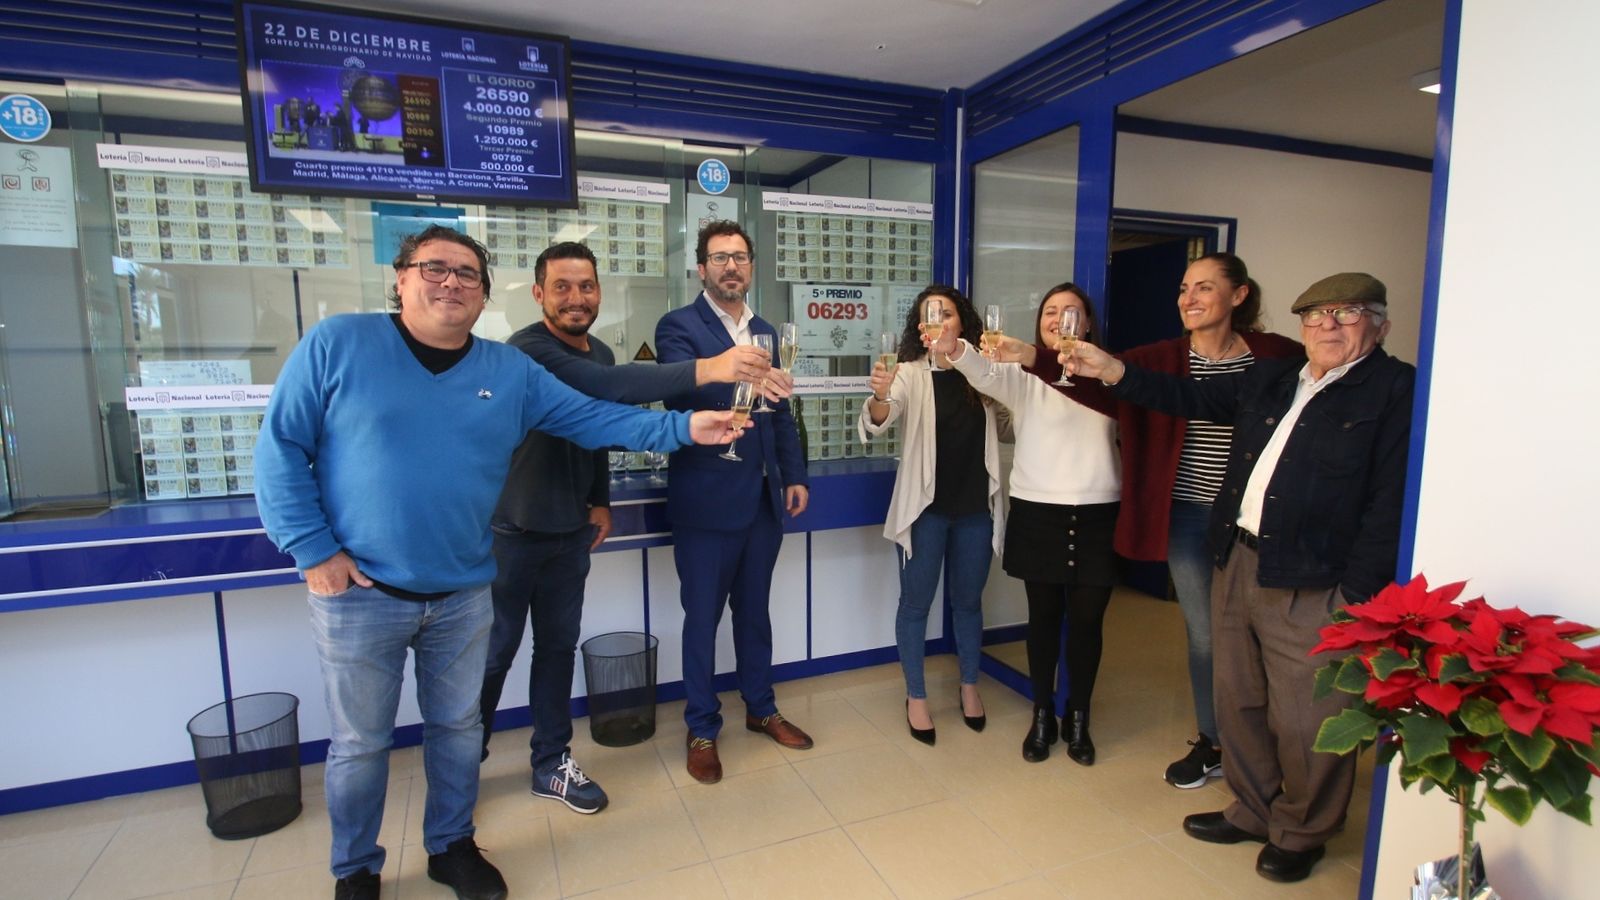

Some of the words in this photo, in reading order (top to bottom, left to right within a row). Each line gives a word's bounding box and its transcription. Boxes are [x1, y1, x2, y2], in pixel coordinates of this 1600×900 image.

[264, 22, 286, 37] 22
[296, 26, 320, 40] DE
[329, 30, 432, 53] DICIEMBRE
[265, 37, 300, 47] SORTEO
[303, 41, 380, 56] EXTRAORDINARIO
[396, 52, 432, 62] NAVIDAD
[467, 73, 484, 84] EL
[487, 75, 536, 89] GORDO
[476, 86, 530, 103] 26590
[463, 101, 531, 117] 4.000.000
[534, 107, 544, 119] €
[466, 113, 508, 125] Segundo
[510, 117, 543, 128] Premio
[487, 124, 525, 136] 10989
[474, 134, 529, 147] 1.250.000
[531, 139, 539, 148] €
[480, 144, 505, 153] Tercer
[506, 146, 535, 155] Premio
[144, 154, 176, 164] Nacional
[221, 160, 249, 169] Naciona
[480, 161, 525, 174] 500.000
[527, 164, 536, 174] €
[293, 169, 330, 179] Madrid,
[370, 174, 412, 184] Alicante,
[413, 176, 447, 186] Murcia,
[448, 179, 456, 187] A
[493, 182, 529, 191] Valencia
[295, 161, 329, 169] Cuarto
[330, 164, 364, 173] premio
[366, 165, 395, 174] 41710
[396, 168, 429, 178] vendido
[447, 171, 495, 182] Barcelona,
[496, 174, 527, 184] Sevilla,
[826, 289, 862, 299] PREMIO
[807, 302, 868, 320] 06293
[171, 392, 202, 400] Nacional
